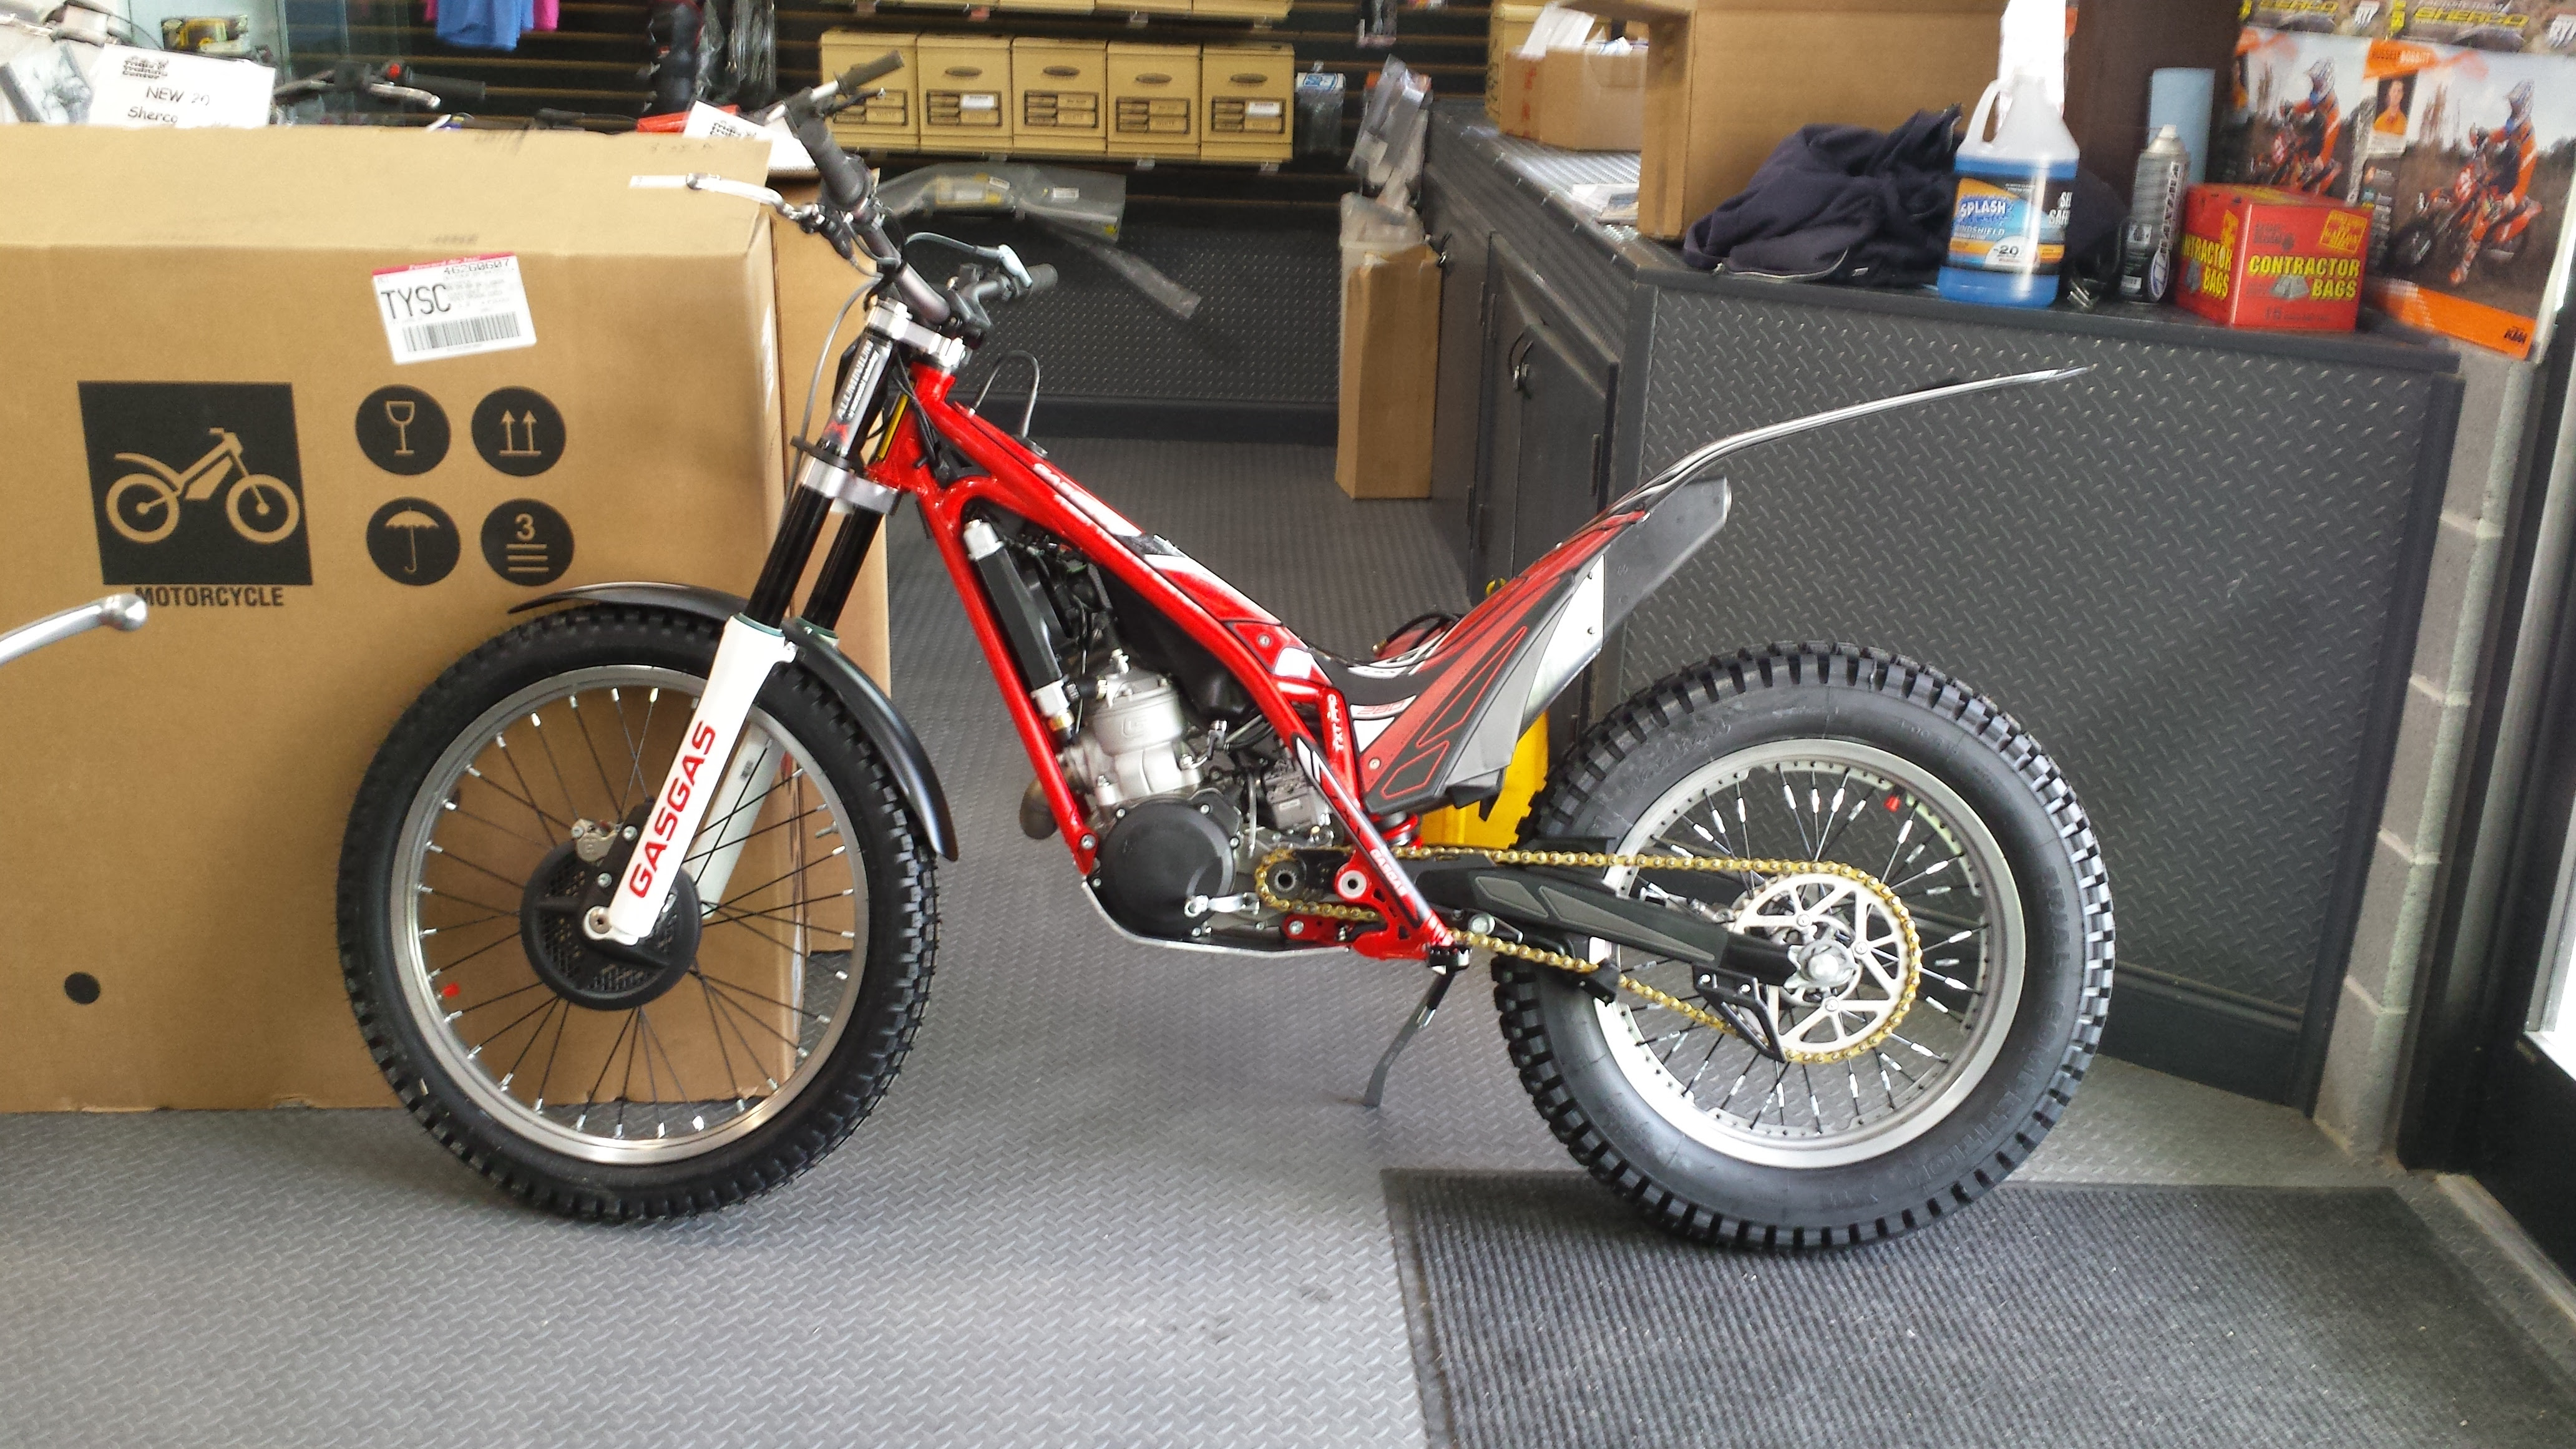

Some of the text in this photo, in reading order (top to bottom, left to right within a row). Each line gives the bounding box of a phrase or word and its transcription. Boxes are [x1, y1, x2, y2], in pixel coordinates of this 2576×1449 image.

[2414, 6, 2529, 27] SHERCO
[145, 85, 185, 103] NEW
[127, 106, 178, 124] Sherco
[1959, 199, 2006, 219] SPLASH
[1993, 245, 2019, 256] -20
[2182, 234, 2233, 271] NTRACTOR
[2248, 255, 2361, 278] CONTRACTOR
[2202, 265, 2230, 300] BAGS
[2310, 278, 2358, 301] BAGS
[381, 283, 451, 320] TYSC
[836, 338, 874, 422] ALUMINIUM
[515, 513, 536, 541] 3
[134, 586, 285, 607] MOTORCYCLE
[629, 720, 716, 899] GASGAS
[1369, 848, 1408, 897] GASGAS
